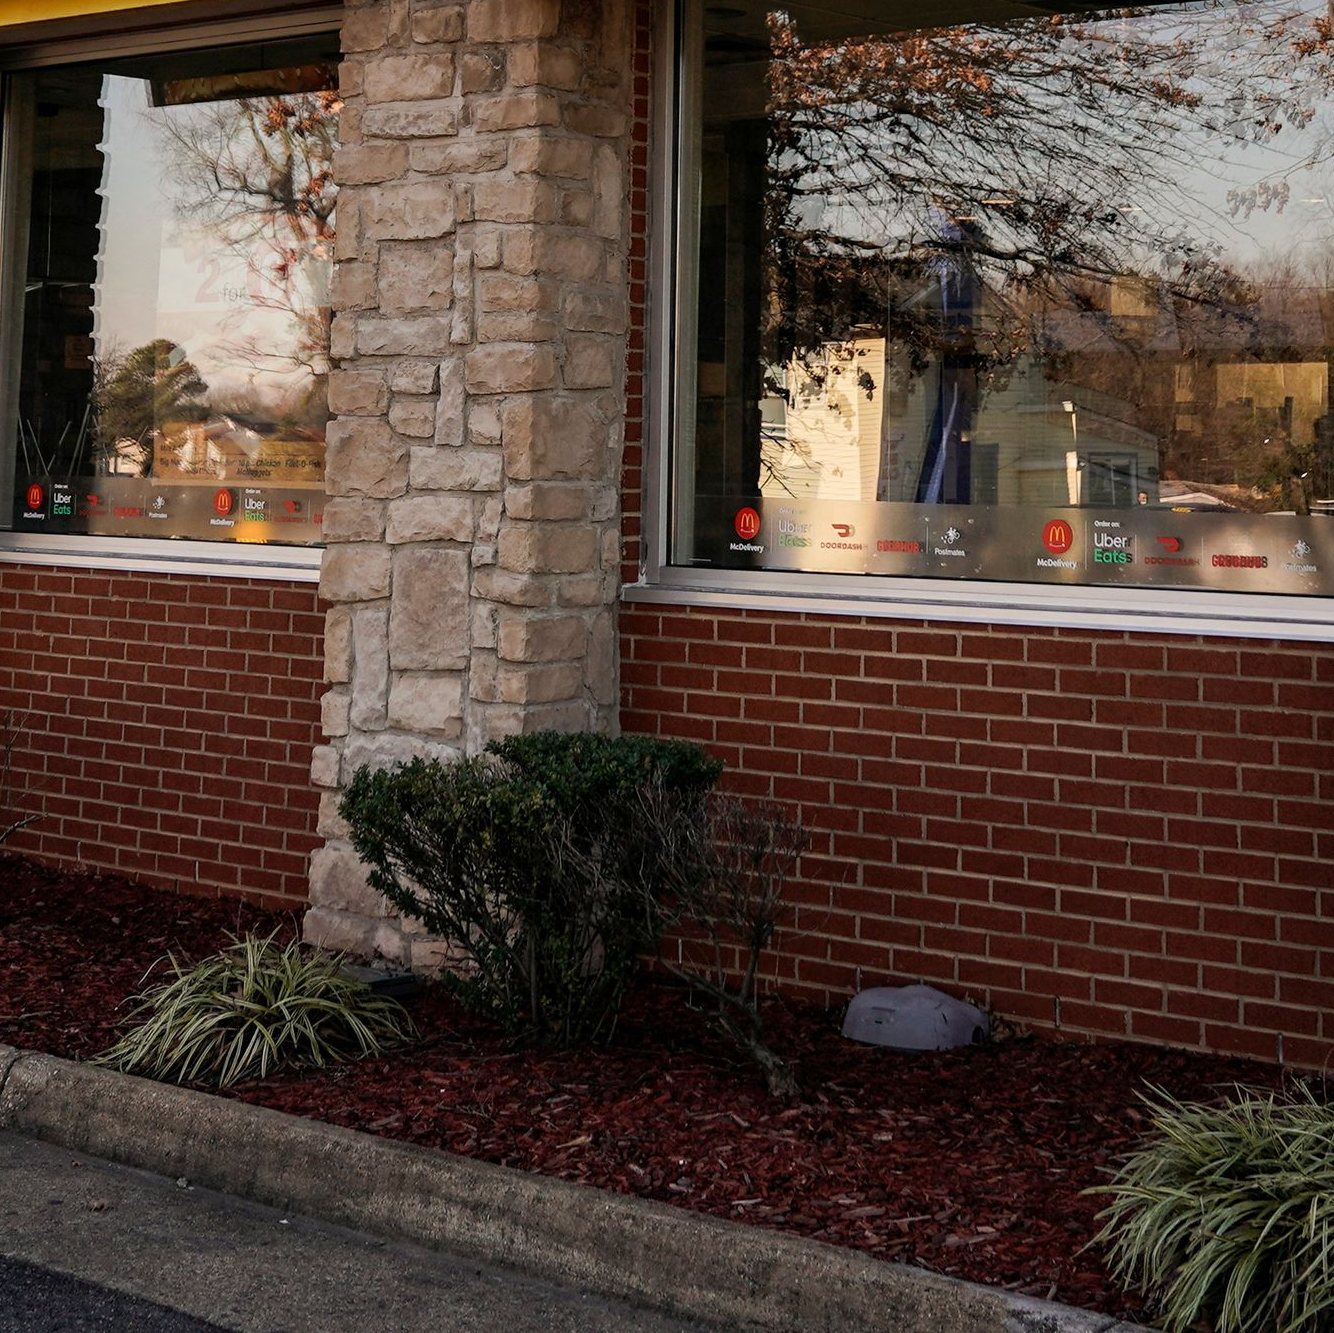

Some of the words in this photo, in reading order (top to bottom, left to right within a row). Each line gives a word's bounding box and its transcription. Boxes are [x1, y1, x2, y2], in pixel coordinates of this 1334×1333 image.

[53, 492, 71, 504] Uber
[245, 498, 265, 510] Uber
[53, 505, 71, 515] Eats
[245, 510, 265, 522] Eats
[820, 541, 863, 551] DOORDASH
[1094, 533, 1128, 547] Uber
[729, 542, 765, 554] McDelivery
[934, 547, 966, 557] Postmates
[1094, 548, 1128, 563] Eats
[1037, 558, 1078, 570] McDelivery
